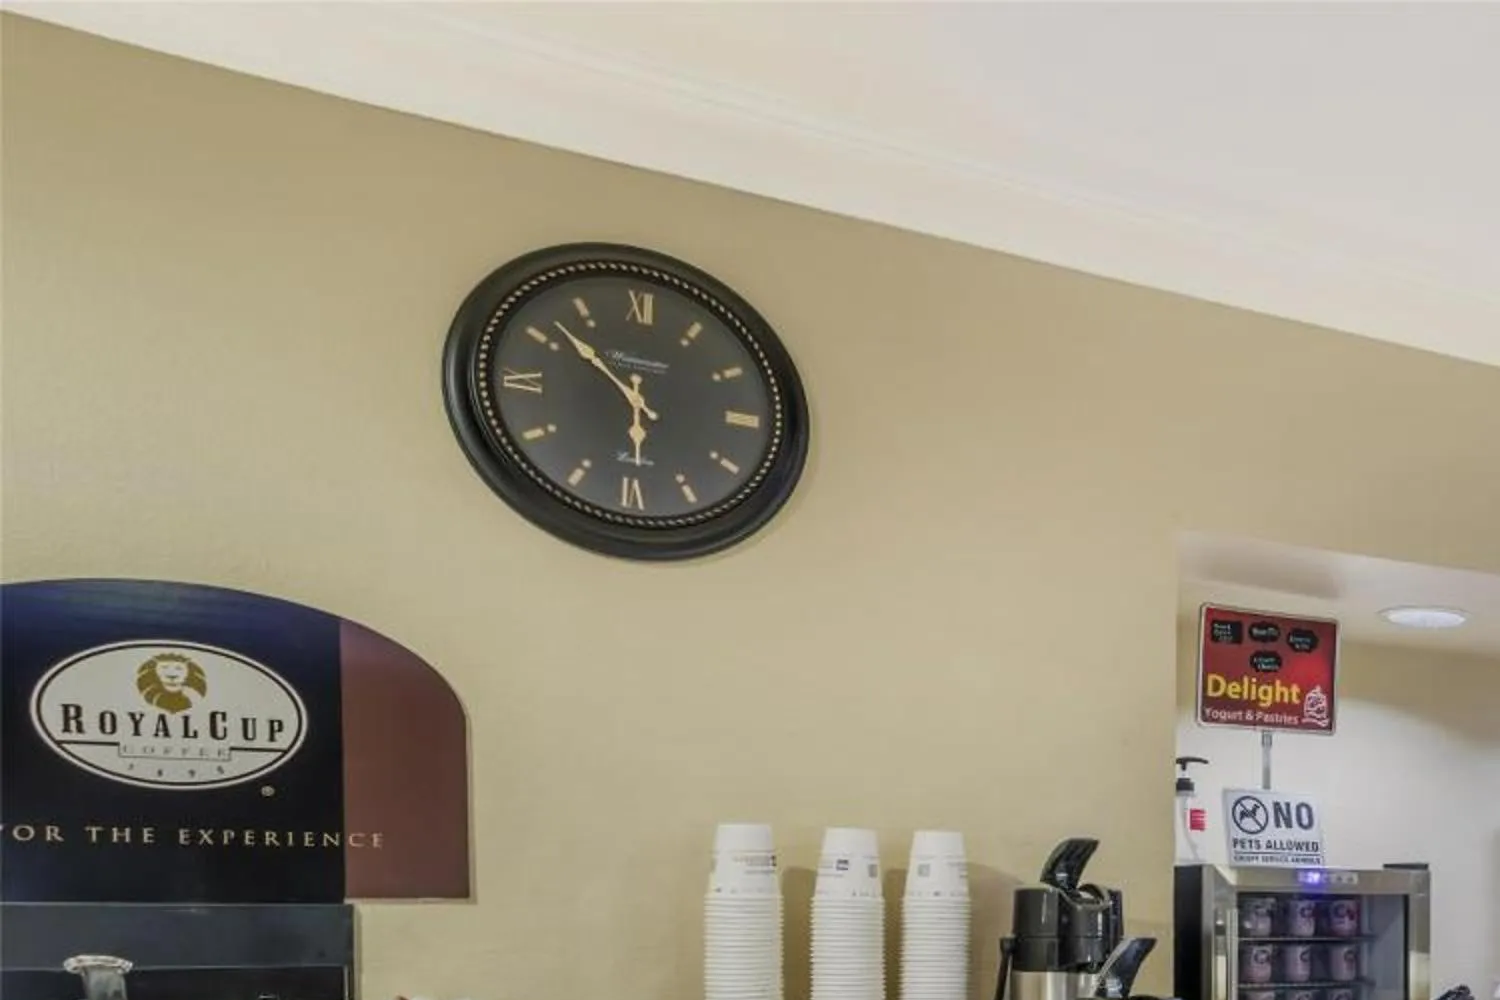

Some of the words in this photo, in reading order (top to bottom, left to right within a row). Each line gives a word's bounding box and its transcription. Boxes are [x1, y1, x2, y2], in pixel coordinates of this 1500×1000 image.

[1206, 673, 1302, 707] Delight
[1204, 708, 1243, 720] Yogurt
[1256, 712, 1299, 725] Pastries
[1272, 801, 1315, 830] NO
[0, 824, 64, 842] OR
[84, 826, 155, 844] THE
[178, 829, 385, 849] EXPERIENCE
[1232, 838, 1262, 850] PETS
[1265, 839, 1320, 852] ALLOWED
